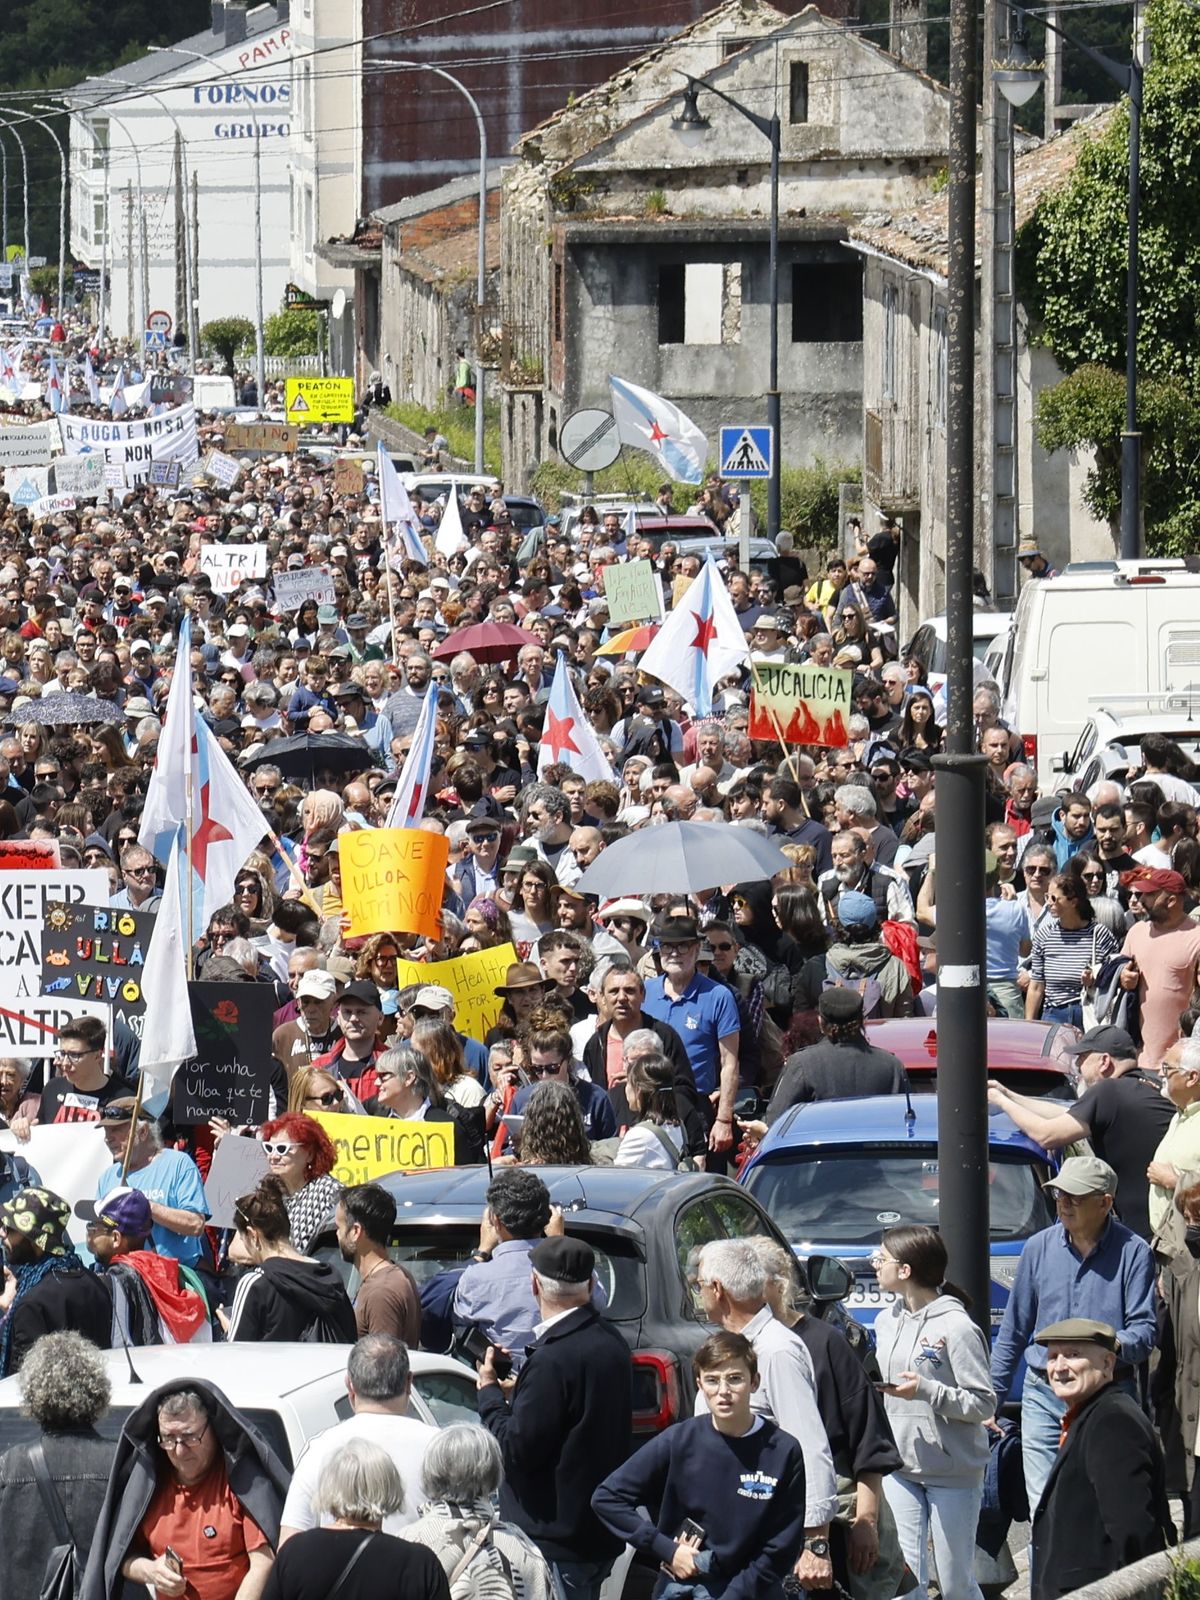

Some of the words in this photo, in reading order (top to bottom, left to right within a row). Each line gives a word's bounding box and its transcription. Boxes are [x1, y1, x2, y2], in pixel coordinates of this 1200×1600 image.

[214, 123, 290, 138] GRUPO
[298, 381, 341, 390] PEATÓN
[66, 425, 74, 440] A
[80, 425, 121, 441] AUGA
[143, 416, 184, 438] NOSA
[125, 444, 153, 462] NON
[756, 667, 846, 703] EUCALICIA
[351, 832, 425, 868] SAVE
[353, 869, 410, 895] ULLOA
[76, 935, 145, 968] ULLA
[75, 971, 140, 1002] VIVO
[469, 993, 490, 1010] FOR
[216, 1056, 257, 1077] unha
[186, 1078, 220, 1098] Ulloa
[227, 1089, 246, 1104] que
[250, 1084, 263, 1098] te
[186, 1103, 239, 1119] namora
[336, 1125, 448, 1167] merican
